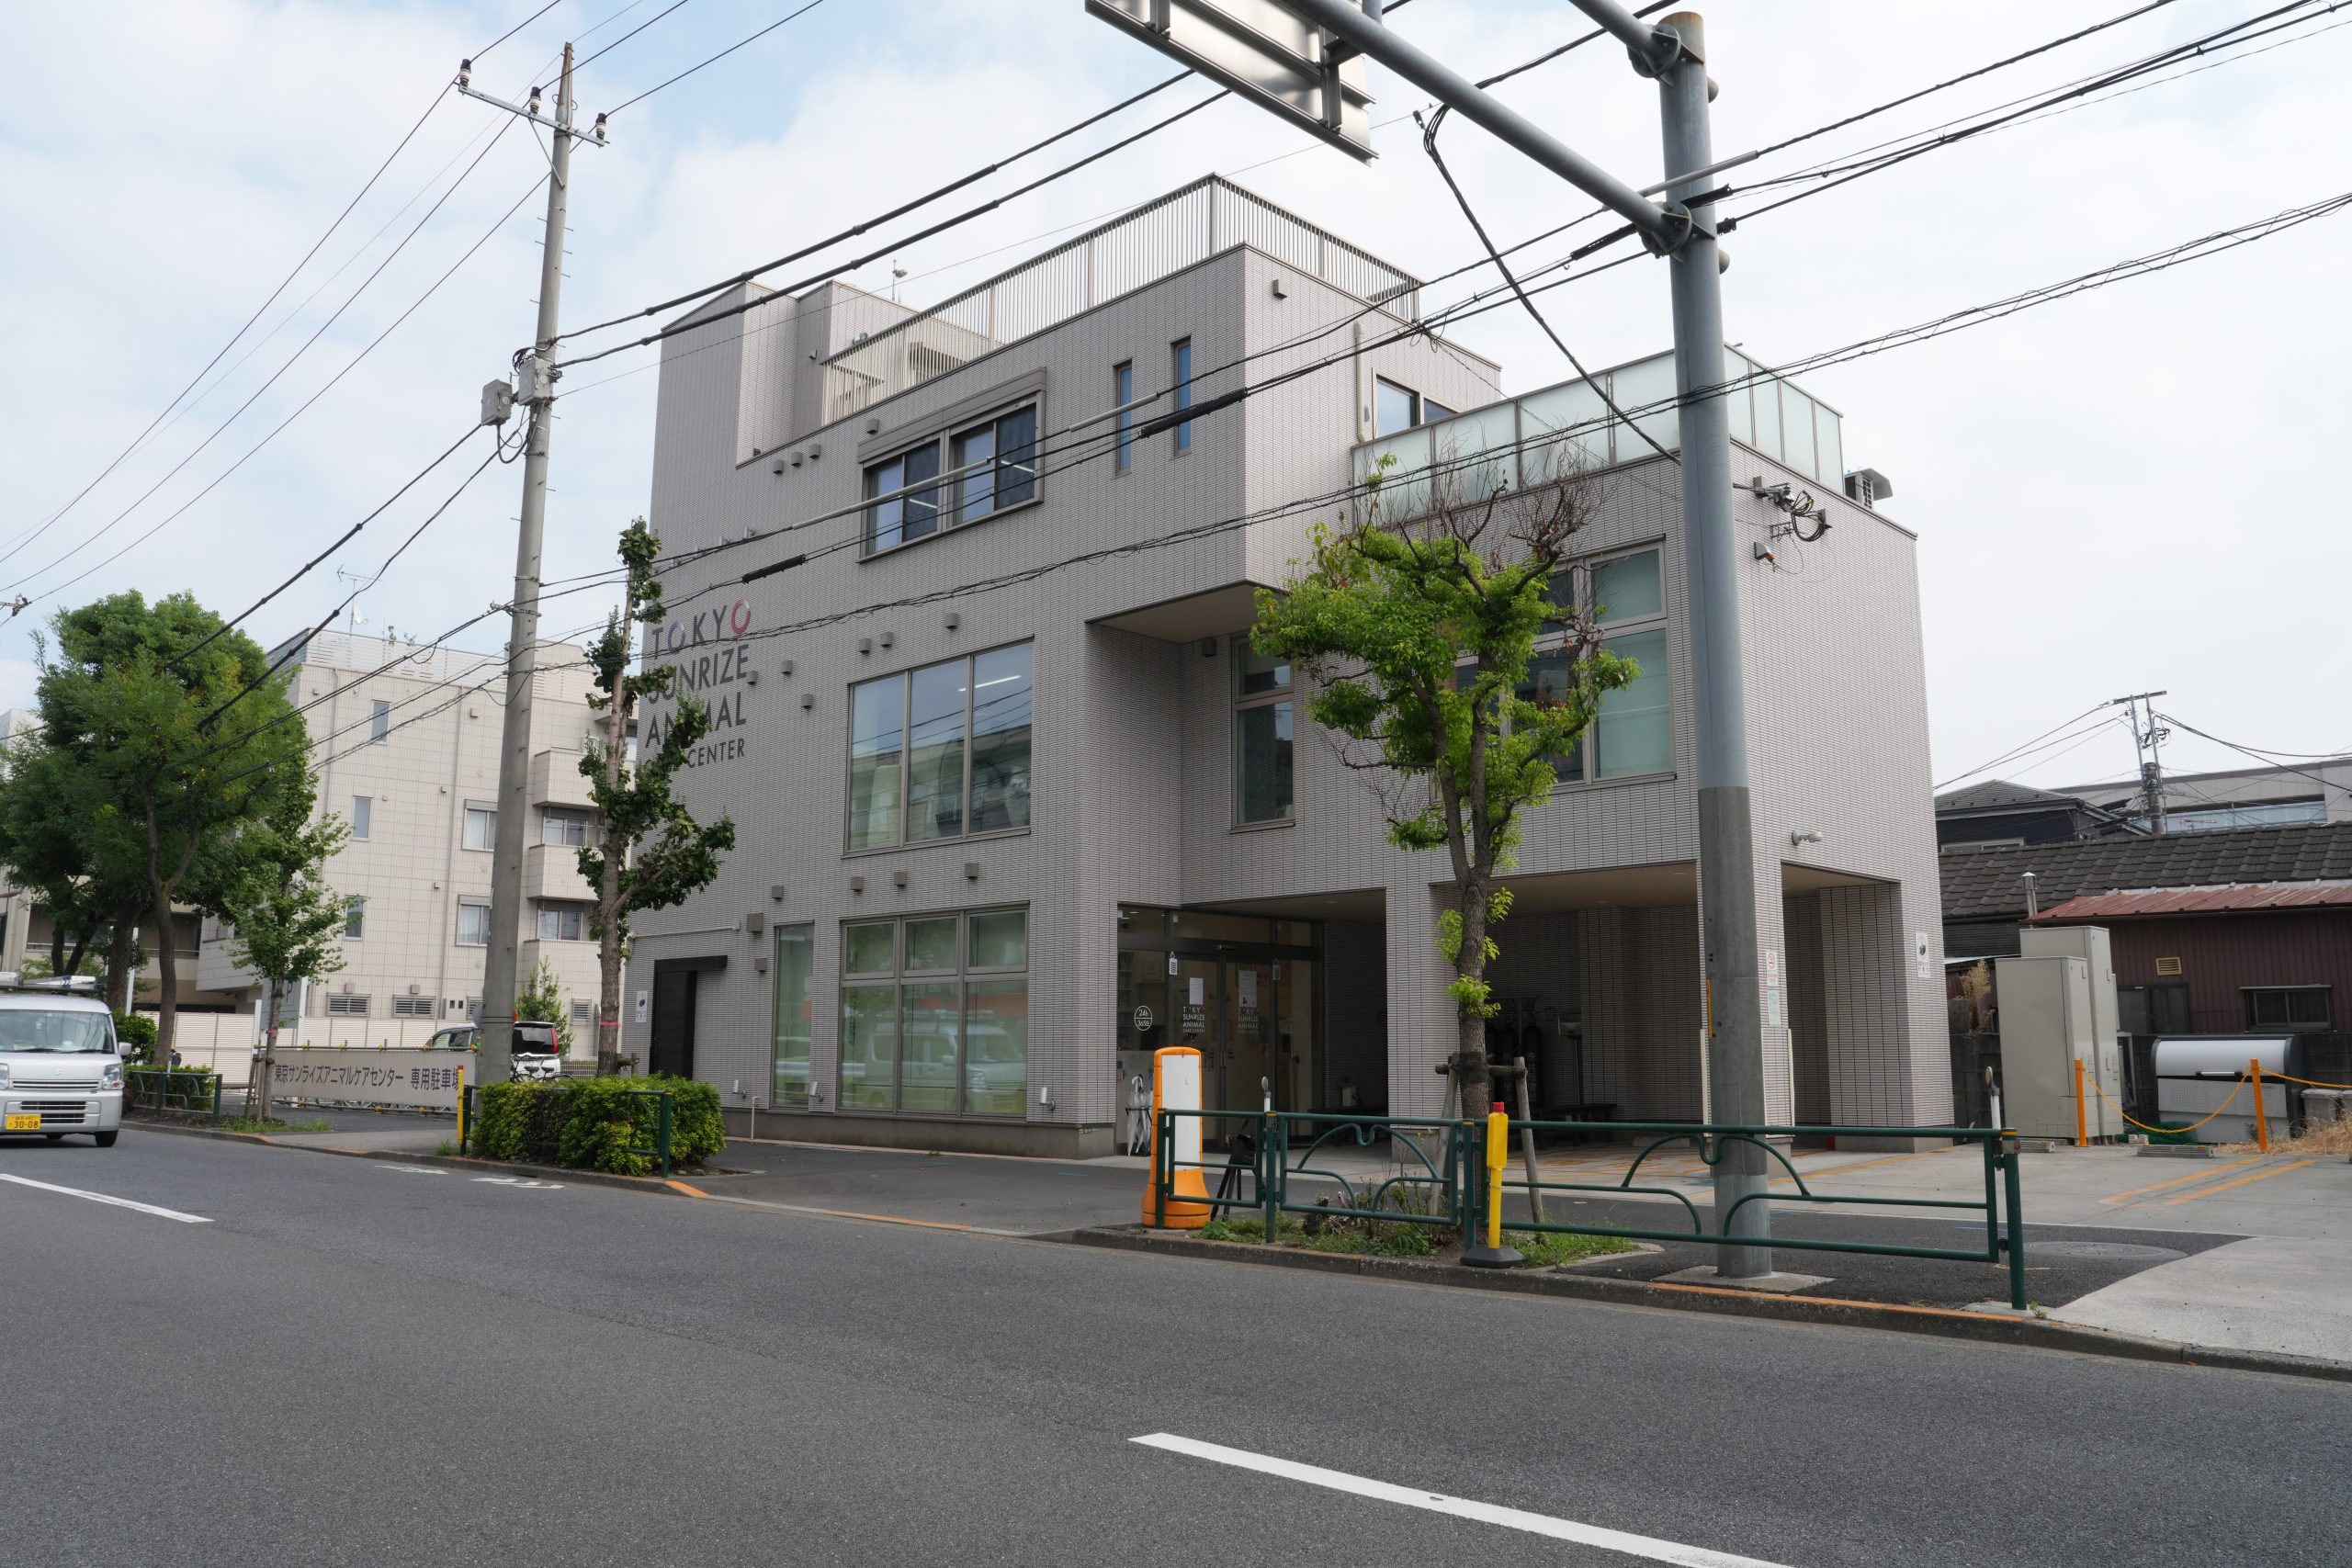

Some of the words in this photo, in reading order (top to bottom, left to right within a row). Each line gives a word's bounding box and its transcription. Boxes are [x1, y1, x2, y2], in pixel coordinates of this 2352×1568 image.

[652, 598, 752, 660] TOKYO
[645, 692, 747, 749] ANAL
[687, 738, 745, 769] CENTER
[1138, 1009, 1149, 1017] 24h
[275, 1064, 404, 1088] 東京サンライズアニマルケアセンター
